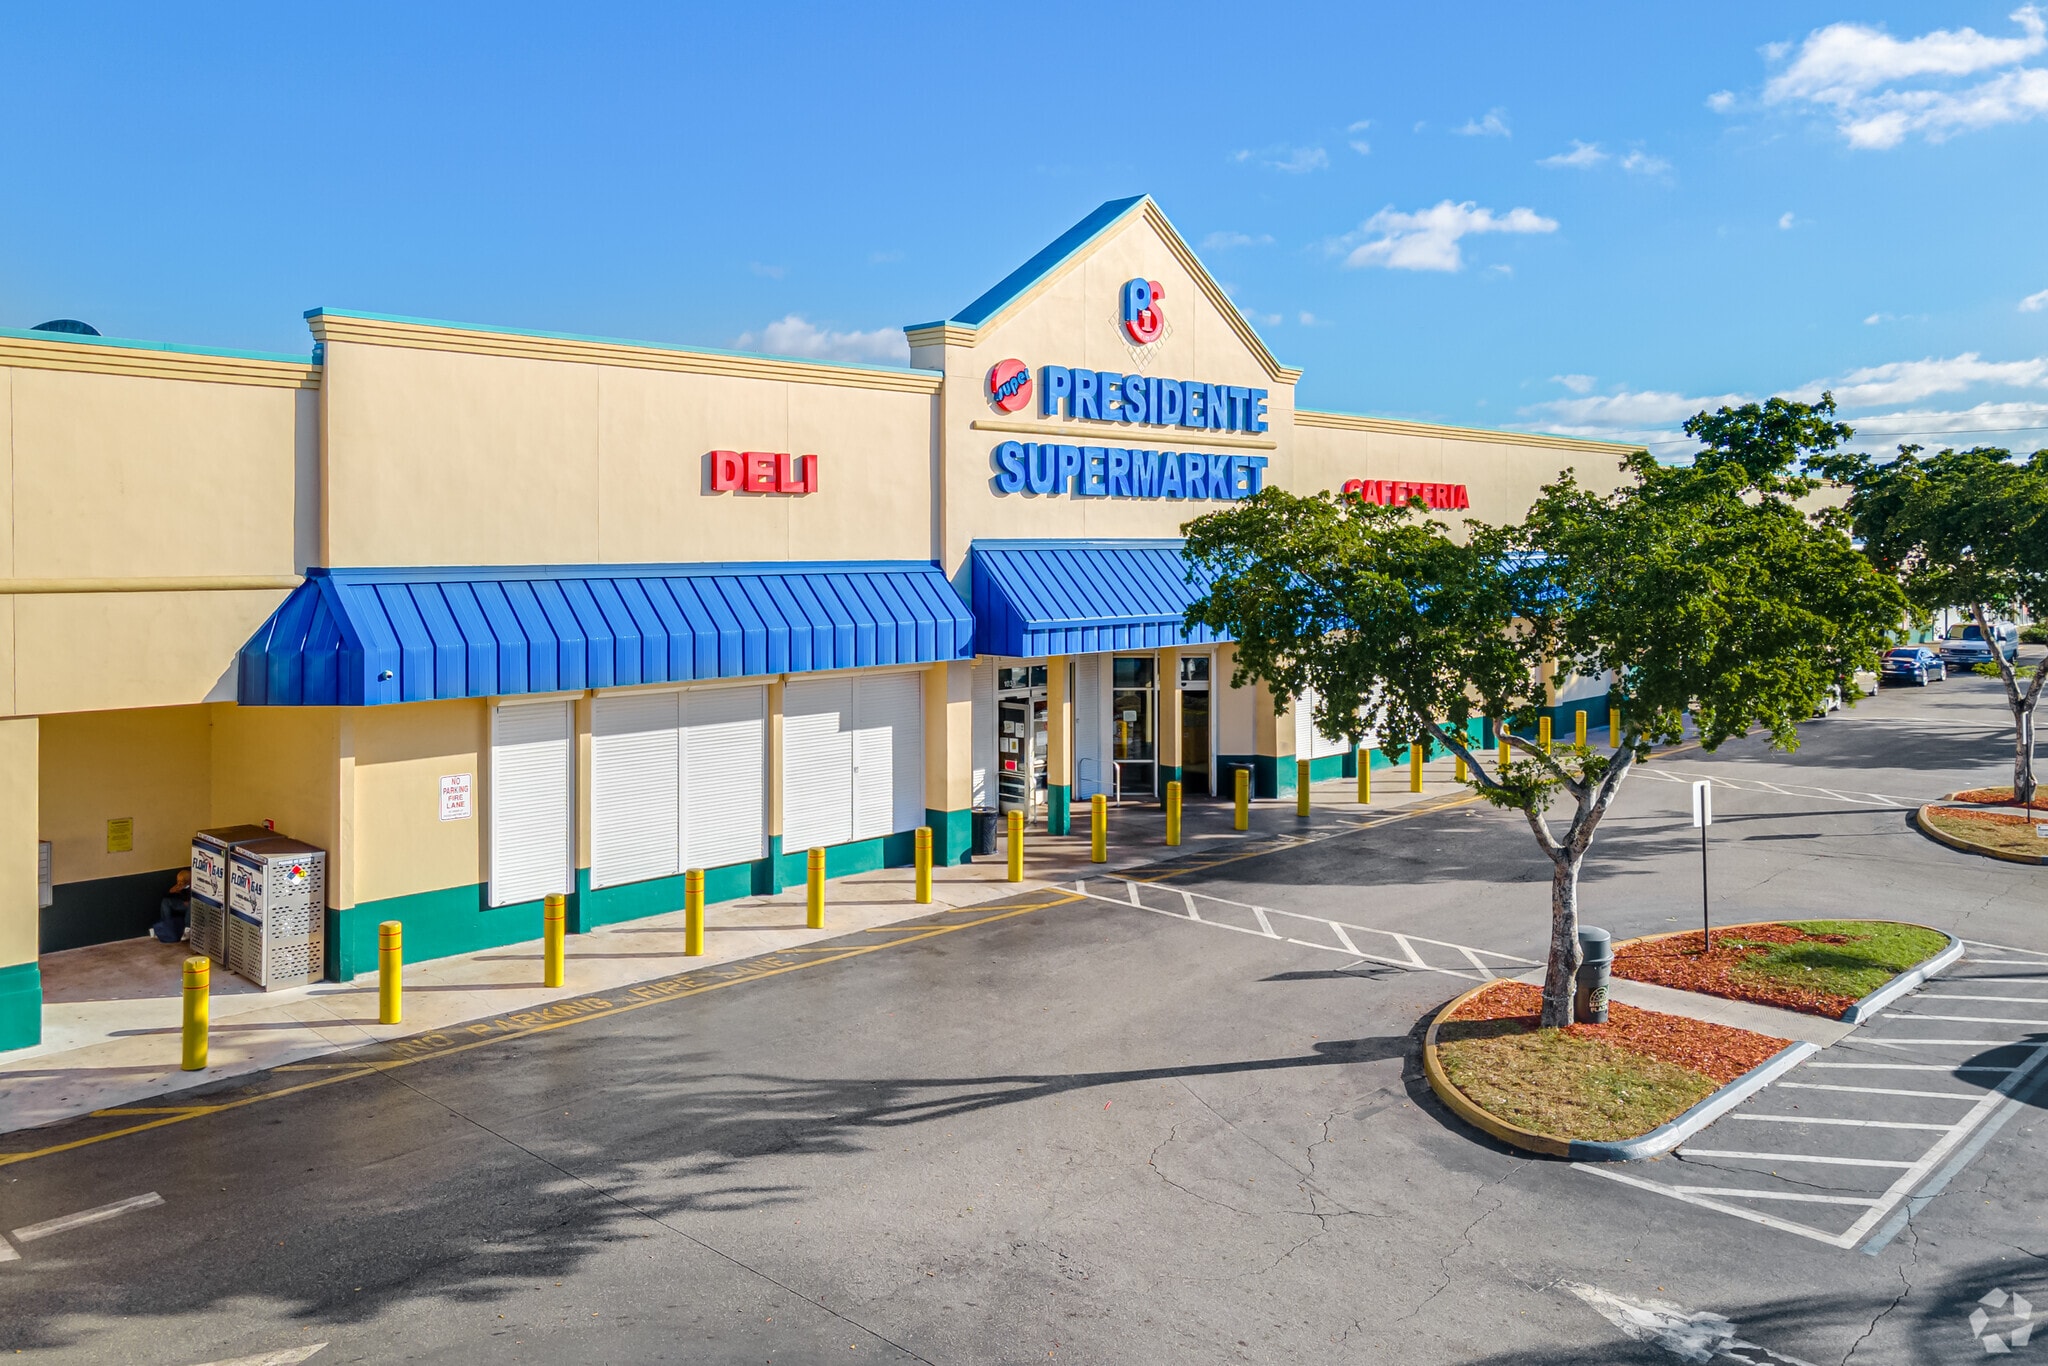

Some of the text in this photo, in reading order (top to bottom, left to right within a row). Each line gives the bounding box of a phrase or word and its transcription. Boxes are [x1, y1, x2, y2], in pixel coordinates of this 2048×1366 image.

[1043, 365, 1268, 433] PRESIDENTE
[711, 450, 818, 493] DELI
[996, 441, 1269, 499] SUPERMARKET
[443, 785, 469, 795] PARKING
[452, 777, 461, 785] NO
[447, 801, 465, 809] LANE
[466, 997, 614, 1036] PARKING
[629, 976, 708, 1000] FIRE
[719, 956, 795, 980] LANE
